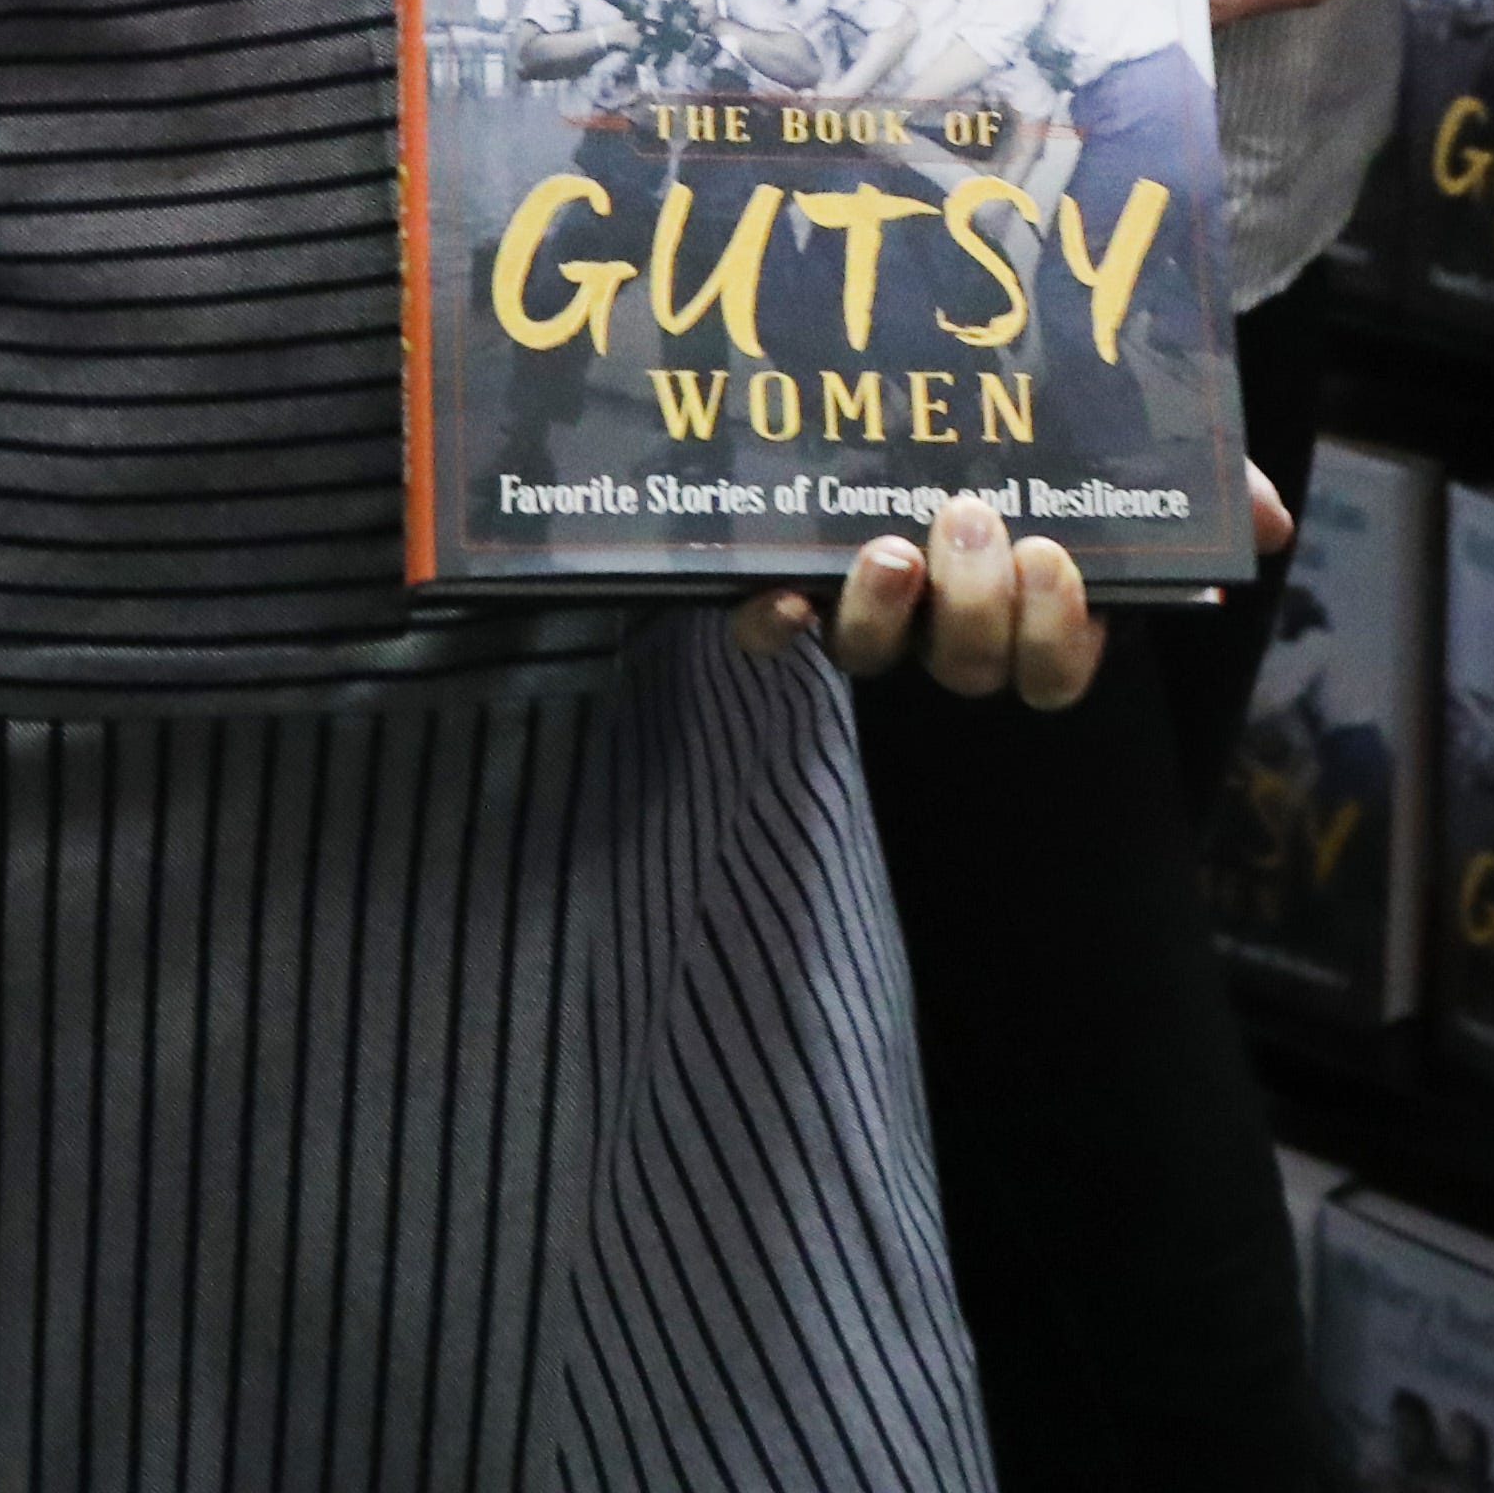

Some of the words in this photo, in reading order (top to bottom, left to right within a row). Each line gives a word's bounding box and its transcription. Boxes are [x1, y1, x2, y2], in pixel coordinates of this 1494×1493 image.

[649, 103, 751, 143] THE
[782, 106, 914, 146] BOOK
[946, 110, 1004, 148] OF
[493, 177, 1167, 361] GUTSY
[649, 369, 1034, 444] WOMEN
[500, 474, 638, 514] Favorite
[646, 474, 766, 514] Stories
[773, 474, 811, 514] of
[1028, 478, 1189, 518] Resilience
